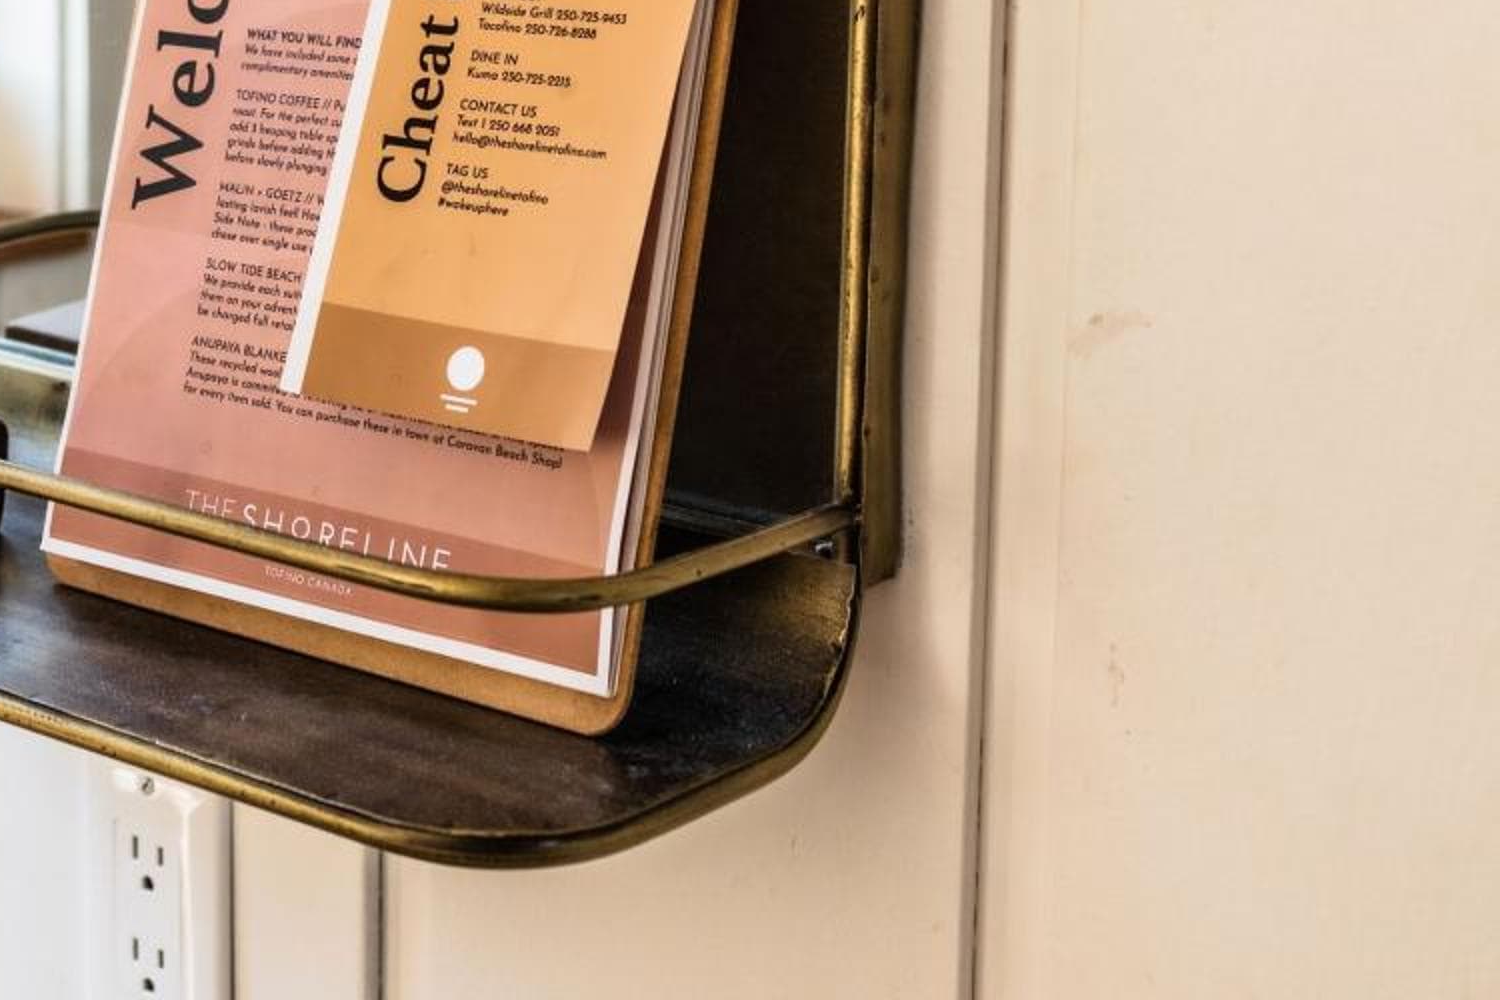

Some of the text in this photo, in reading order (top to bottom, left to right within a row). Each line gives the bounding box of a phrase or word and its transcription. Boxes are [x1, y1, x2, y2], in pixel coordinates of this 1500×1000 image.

[481, 2, 527, 17] Wildside
[529, 6, 554, 19] Grill
[479, 17, 522, 33] Tacofino
[247, 28, 363, 50] WHAT YOU WILL FIND
[245, 43, 259, 55] We
[261, 46, 283, 58] have
[326, 55, 351, 65] some
[470, 49, 519, 66] DINE IN
[467, 66, 499, 81] Kuma
[236, 89, 320, 109] TOFINO COFFEE
[376, 14, 459, 203] Cheat
[459, 98, 538, 118] CONTACT US
[457, 113, 479, 127] Text
[489, 119, 511, 131] 250
[447, 162, 489, 180] TAG US
[205, 257, 237, 272] SLOW
[241, 263, 263, 277] TIDE
